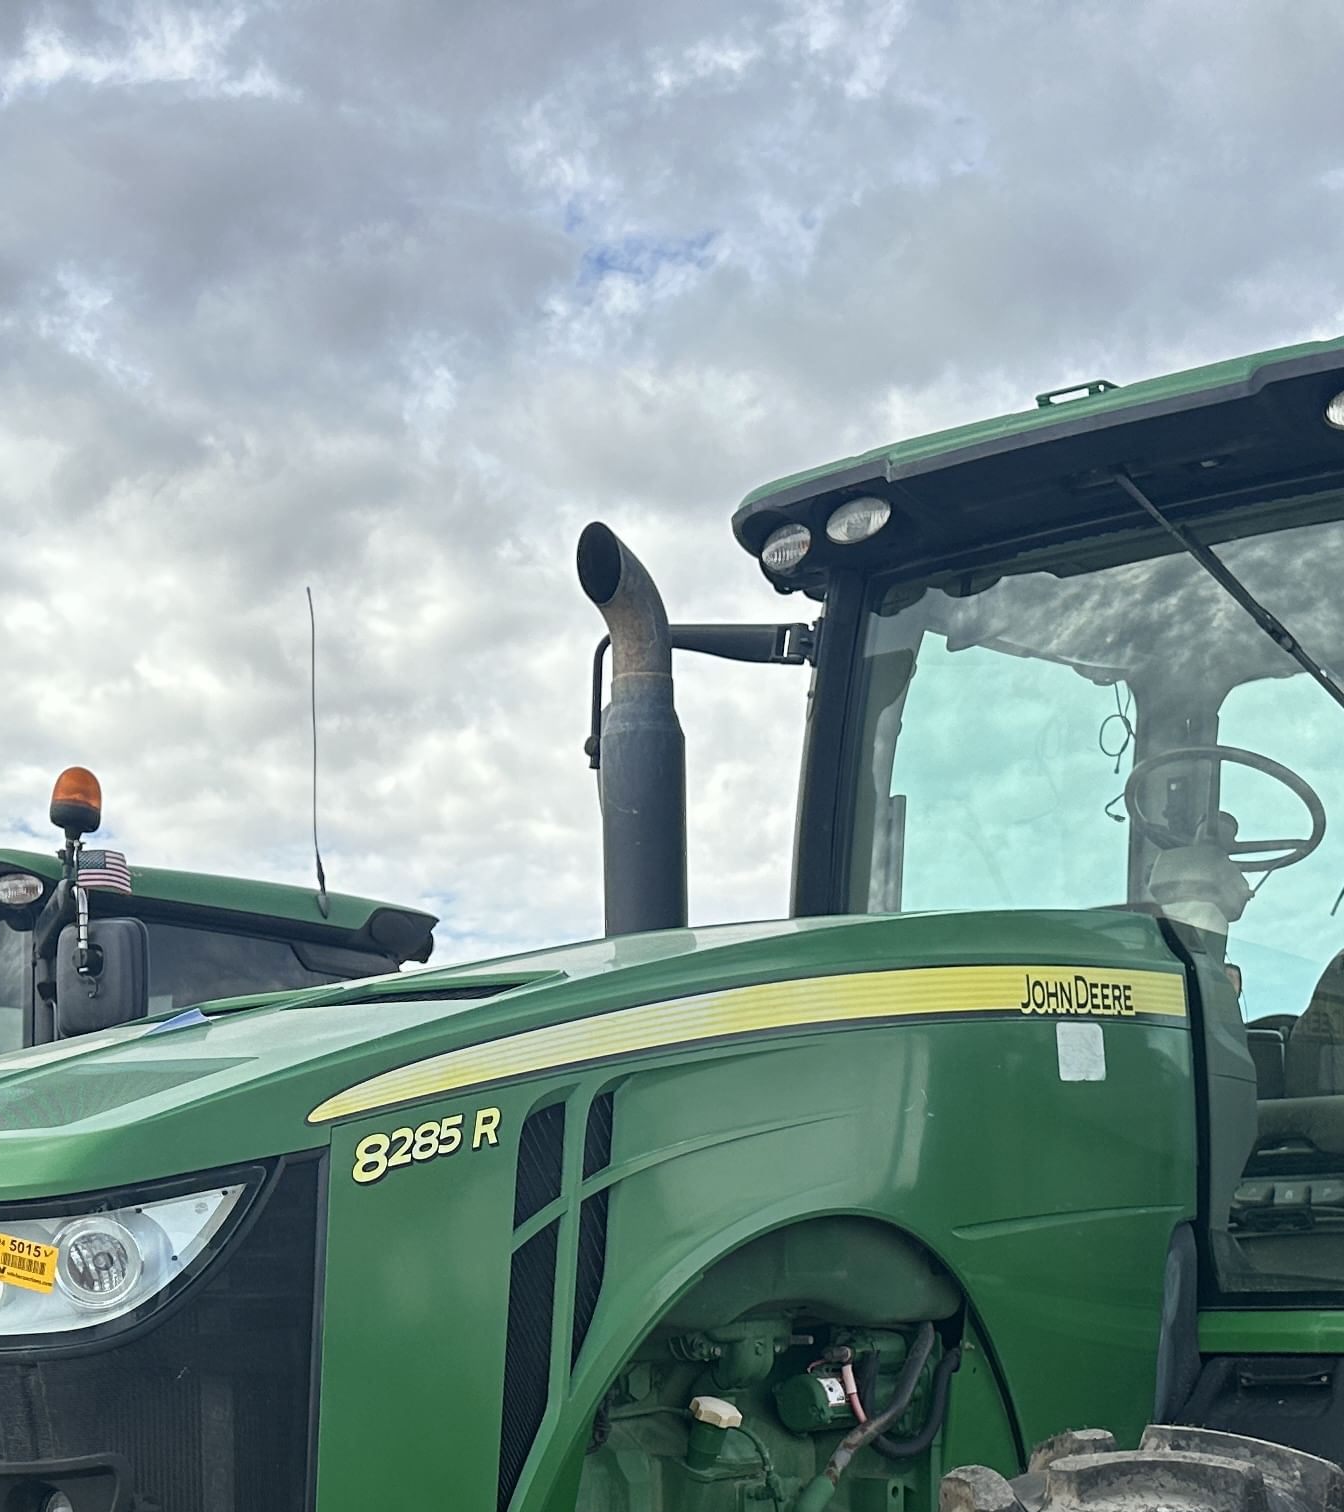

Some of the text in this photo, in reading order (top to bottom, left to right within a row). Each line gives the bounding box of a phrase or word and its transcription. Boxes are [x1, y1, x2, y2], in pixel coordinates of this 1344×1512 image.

[1020, 973, 1135, 1012] JOHN DEERE
[352, 1106, 502, 1185] 8285 R
[9, 1239, 42, 1258] 5015
